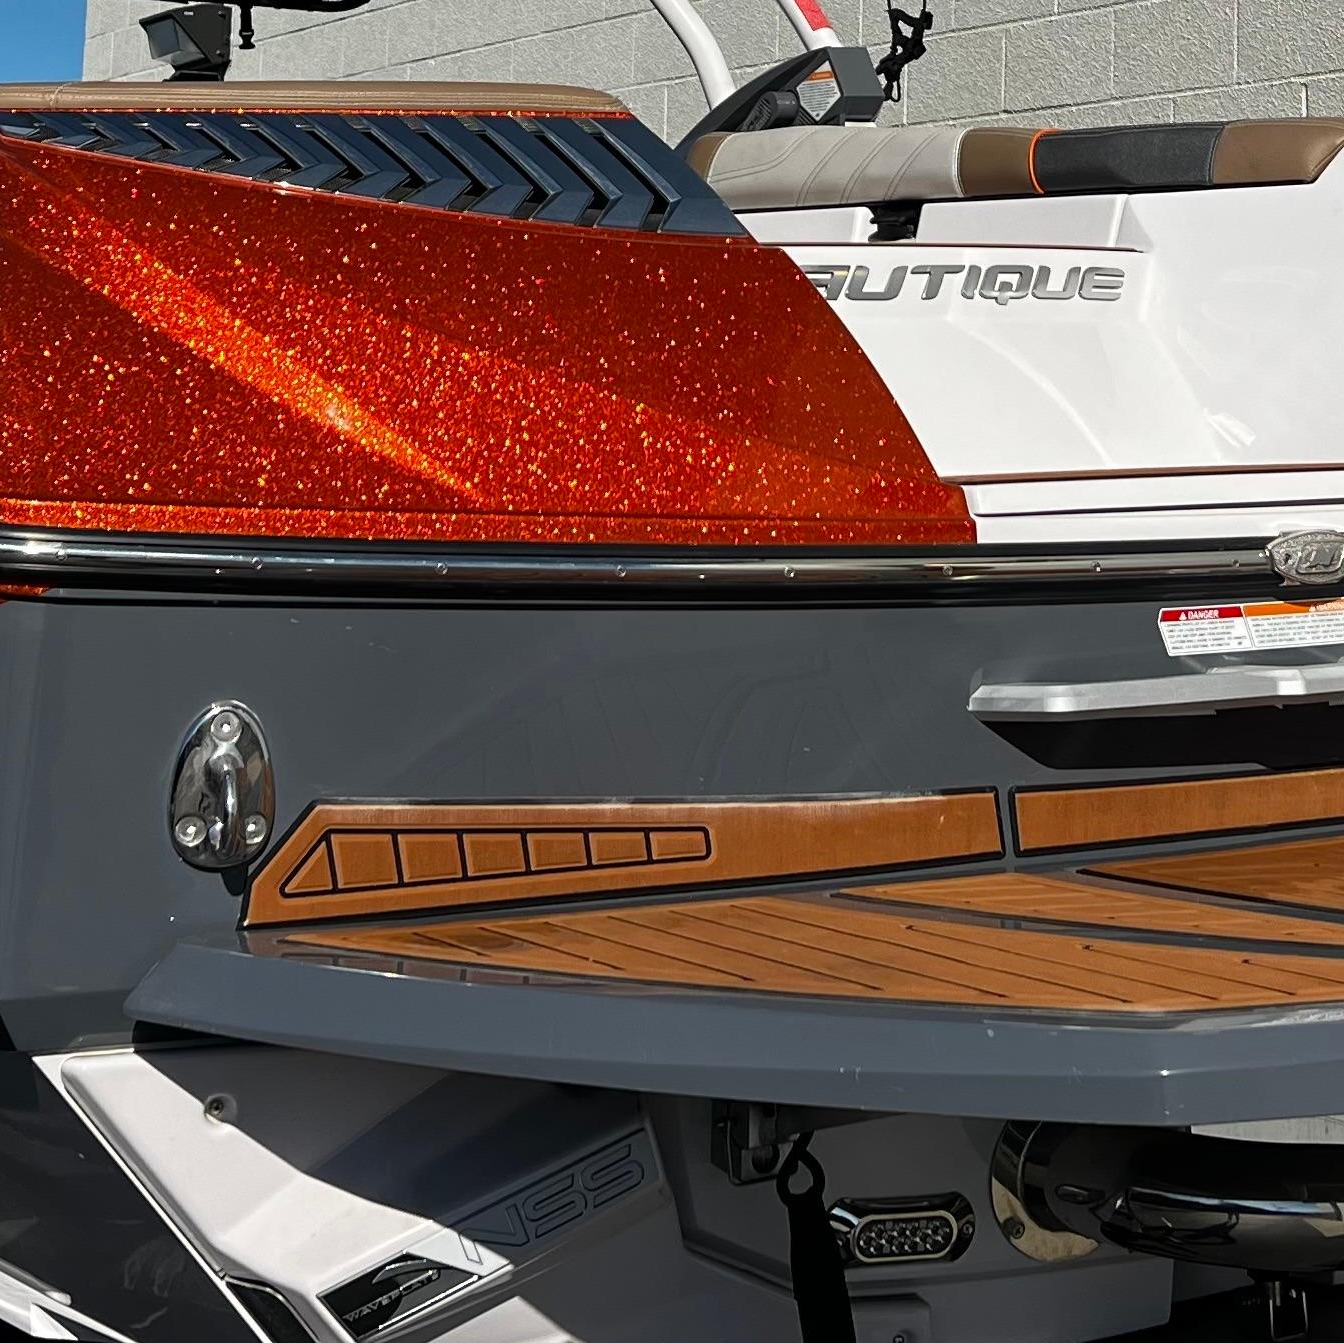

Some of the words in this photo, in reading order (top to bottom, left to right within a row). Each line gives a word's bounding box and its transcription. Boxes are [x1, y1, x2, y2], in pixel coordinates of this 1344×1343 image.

[801, 264, 1126, 306] AUTIQUE
[1187, 609, 1220, 621] DANGER
[458, 1143, 646, 1266] NSS
